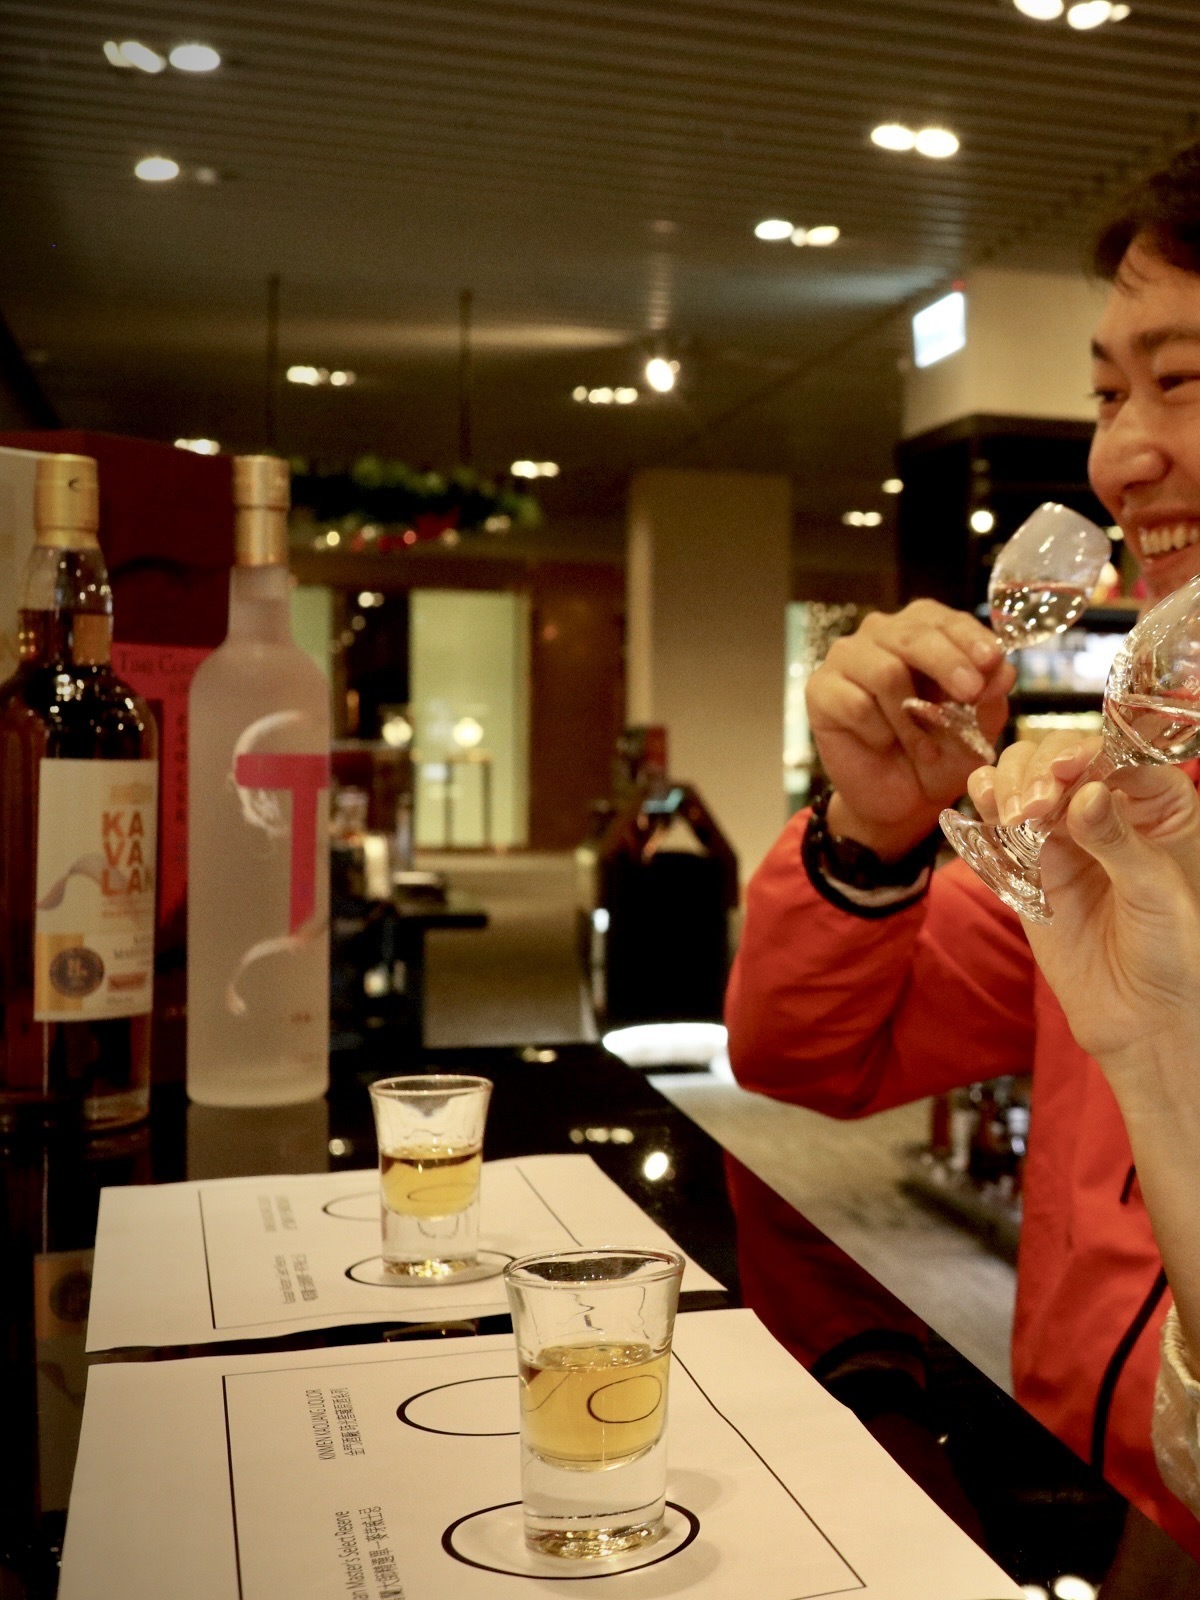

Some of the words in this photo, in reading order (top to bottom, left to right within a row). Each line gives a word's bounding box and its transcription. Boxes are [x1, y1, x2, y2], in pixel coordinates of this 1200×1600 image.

[102, 812, 144, 838] KA
[103, 840, 144, 867] VA
[305, 1388, 325, 1408] LIQUOR
[309, 1409, 331, 1436] KAOLIANG
[315, 1437, 336, 1460] KINMEN
[334, 1511, 354, 1536] Reserve
[337, 1535, 359, 1558] Select
[341, 1558, 366, 1590] Master's
